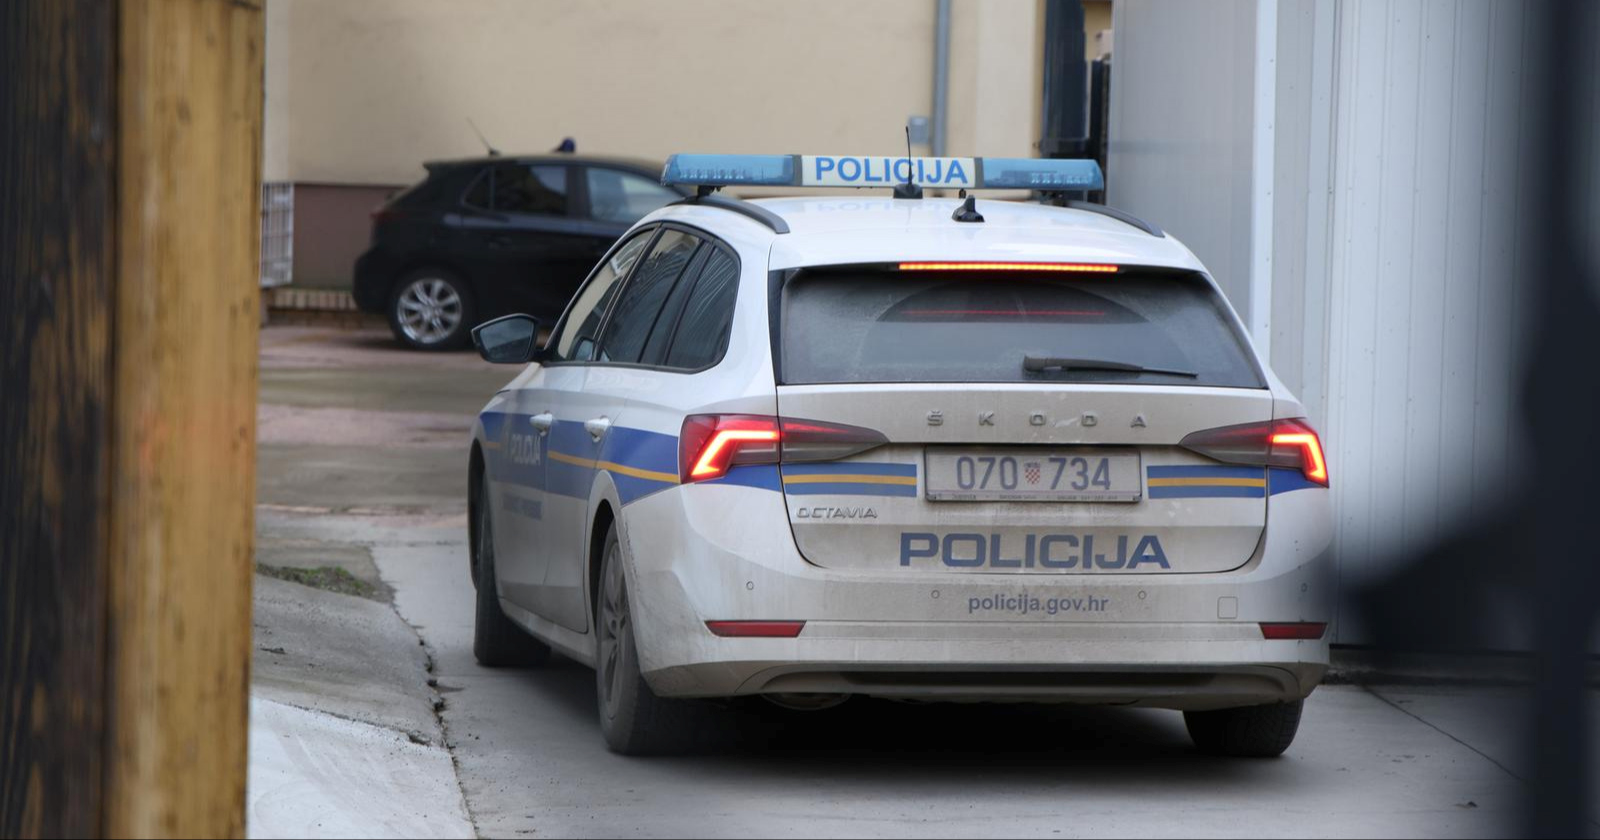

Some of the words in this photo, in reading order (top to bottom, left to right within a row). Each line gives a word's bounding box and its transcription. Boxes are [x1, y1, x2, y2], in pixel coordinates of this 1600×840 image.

[815, 157, 968, 184] POLICIJA
[927, 411, 1147, 428] ŠKODA
[956, 456, 1018, 490] 070
[1048, 457, 1111, 490] 734
[796, 507, 878, 519] OCTAVIA
[899, 533, 1171, 569] POLICIJA
[968, 593, 1109, 615] policija.gov.hr
